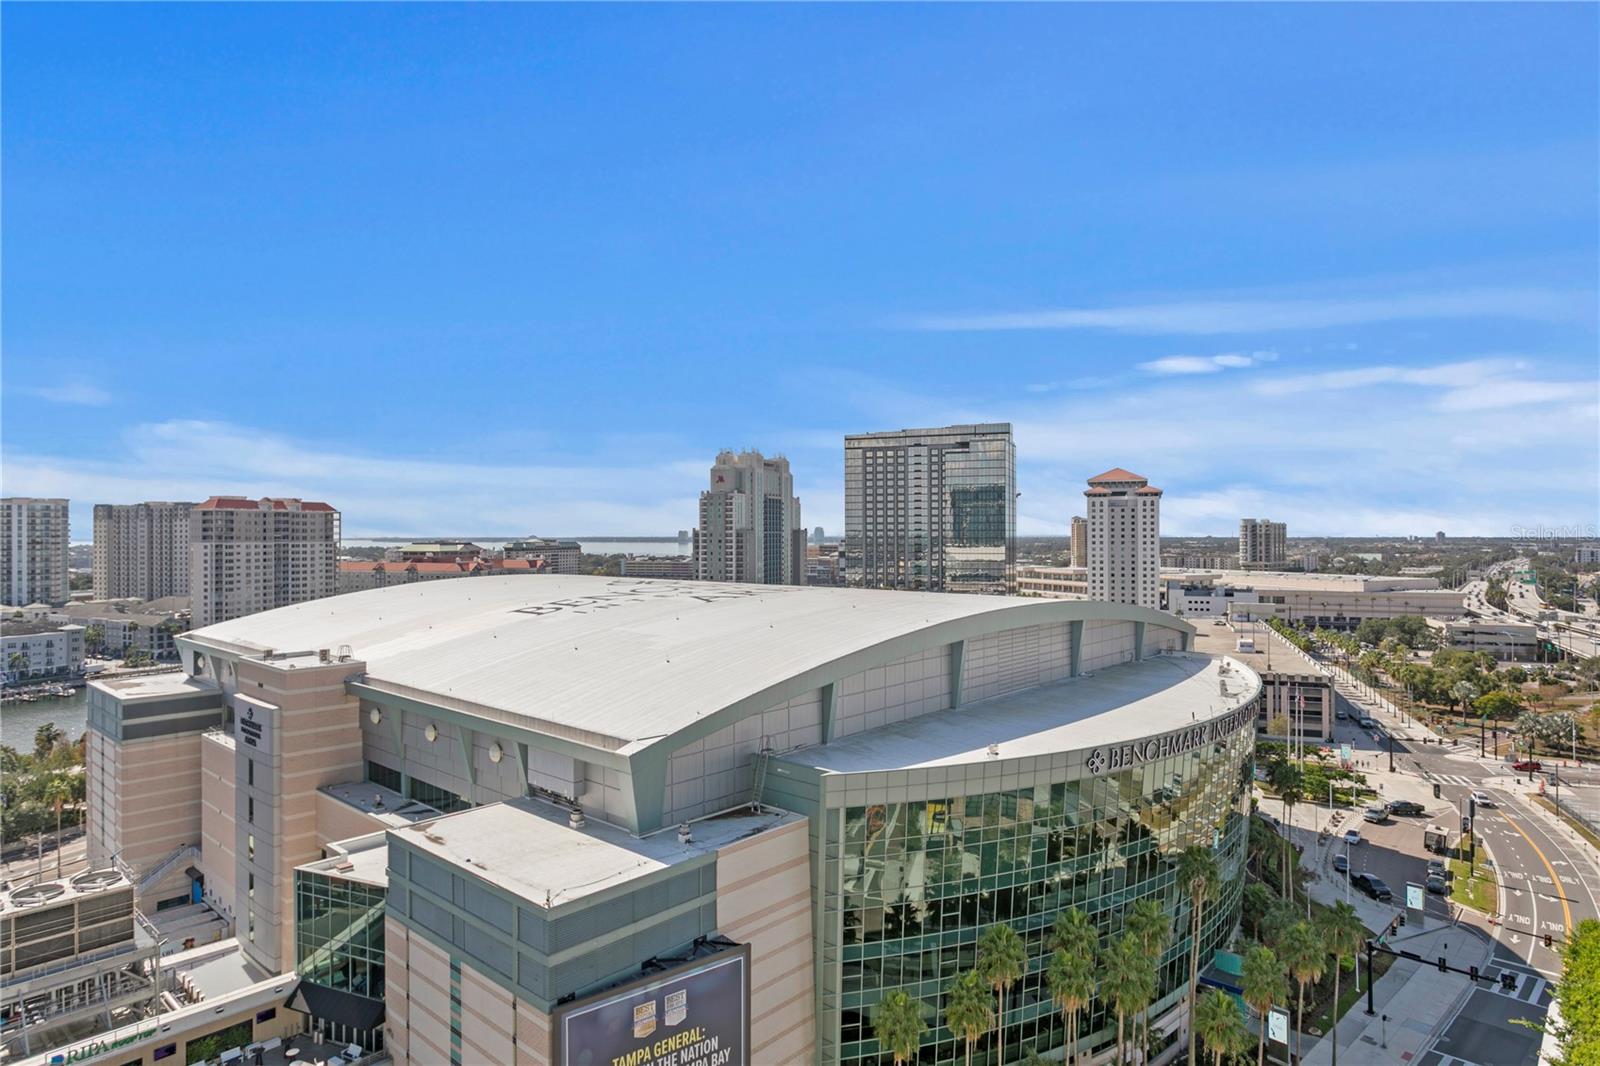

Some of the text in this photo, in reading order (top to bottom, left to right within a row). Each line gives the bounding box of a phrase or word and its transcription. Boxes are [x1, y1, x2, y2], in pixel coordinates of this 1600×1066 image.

[1110, 726, 1207, 770] BENCHMARK
[1508, 914, 1531, 924] ONLY
[1541, 921, 1564, 931] ONLY
[66, 1040, 110, 1065] RIPA
[612, 1026, 706, 1066] TAMPA GENERAL:
[656, 1051, 679, 1066] THE
[680, 1035, 719, 1065] NATION
[711, 1047, 732, 1066] BAY
